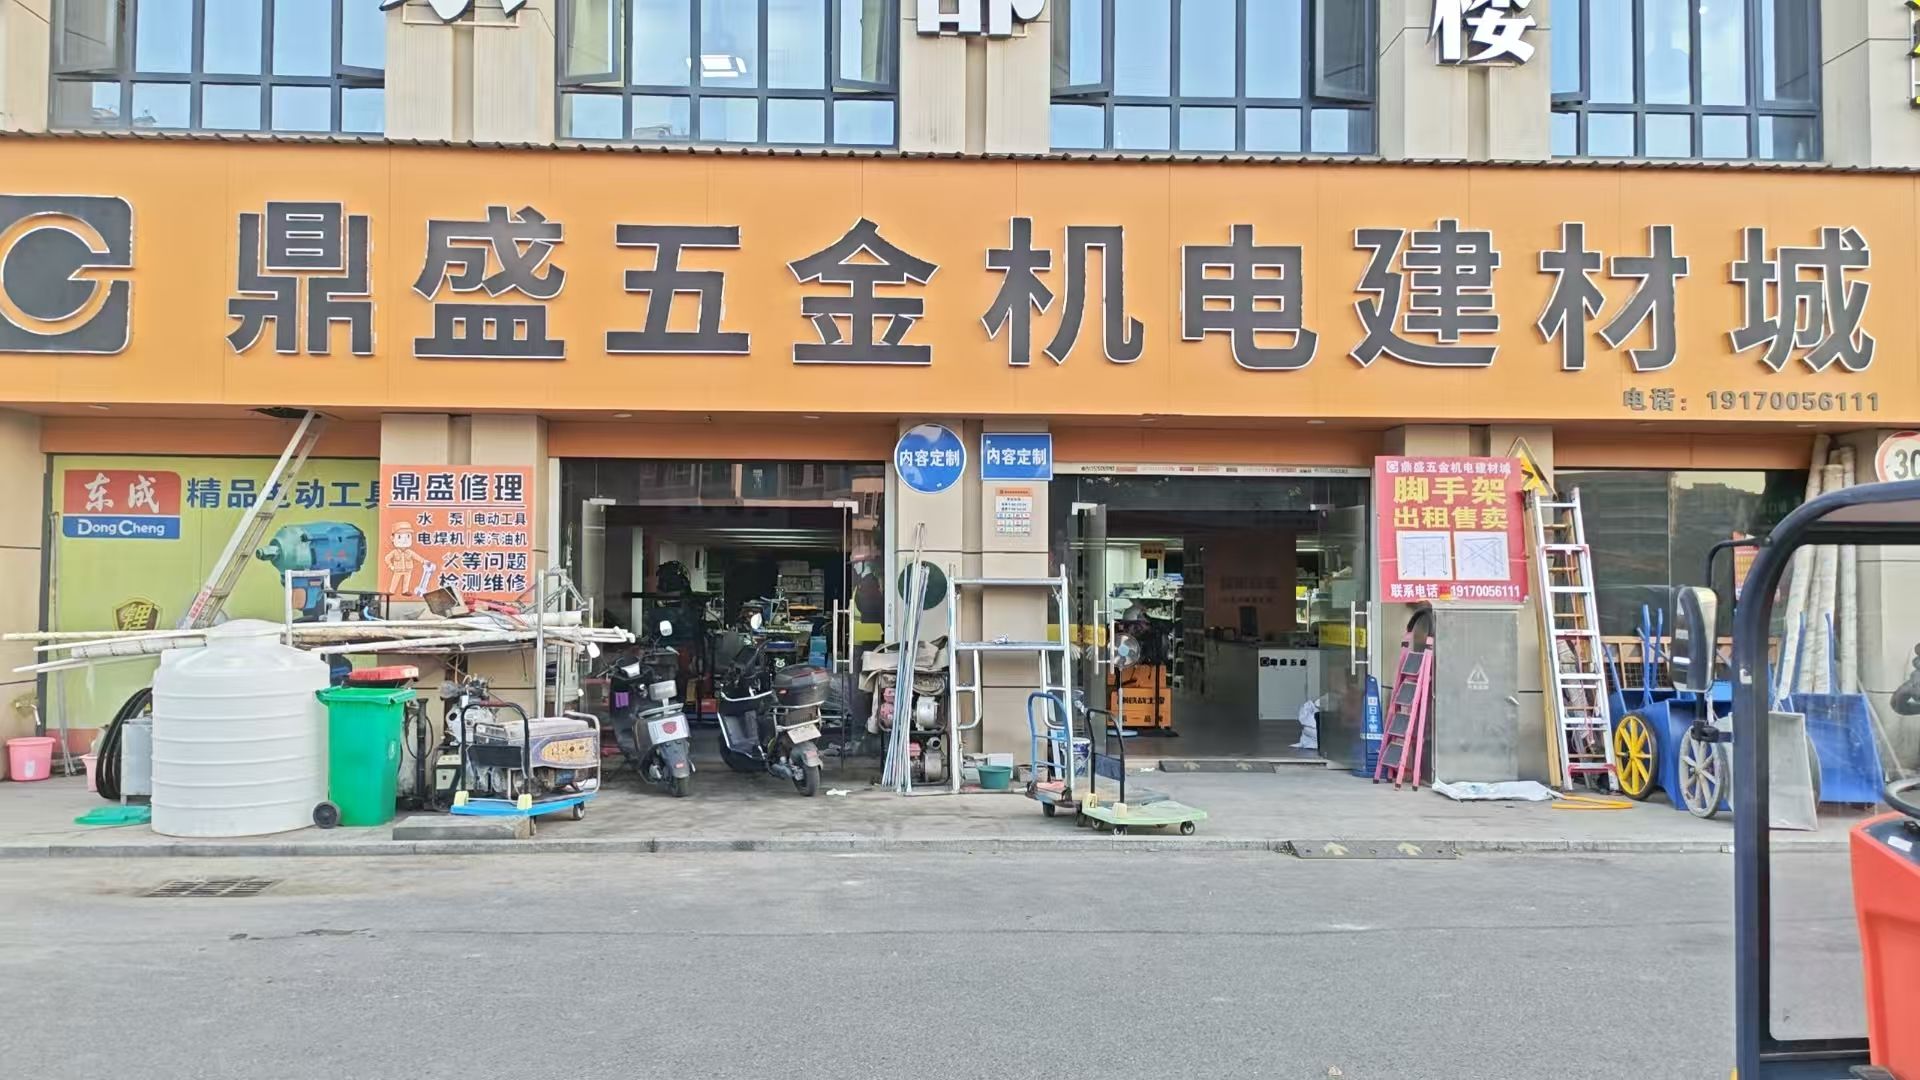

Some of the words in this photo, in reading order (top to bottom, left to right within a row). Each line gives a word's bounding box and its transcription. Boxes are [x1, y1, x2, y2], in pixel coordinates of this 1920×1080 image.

[225, 200, 1876, 373] 鼎盛五金机电建材城
[1706, 391, 1879, 411] 19170056111
[900, 449, 960, 467] 内容定制
[986, 448, 1047, 465] 内容定制
[84, 472, 160, 514] 东成
[392, 473, 523, 501] 鼎盛修理
[1394, 476, 1507, 505] 脚手架
[474, 512, 526, 526] 电动工具
[1394, 506, 1509, 529] 出租售卖
[417, 532, 464, 546] 电焊机
[473, 532, 527, 546] 柴汽油机
[439, 573, 526, 593] 检测维修
[1391, 583, 1439, 599] 联系电话
[1450, 584, 1520, 598] 19170056111
